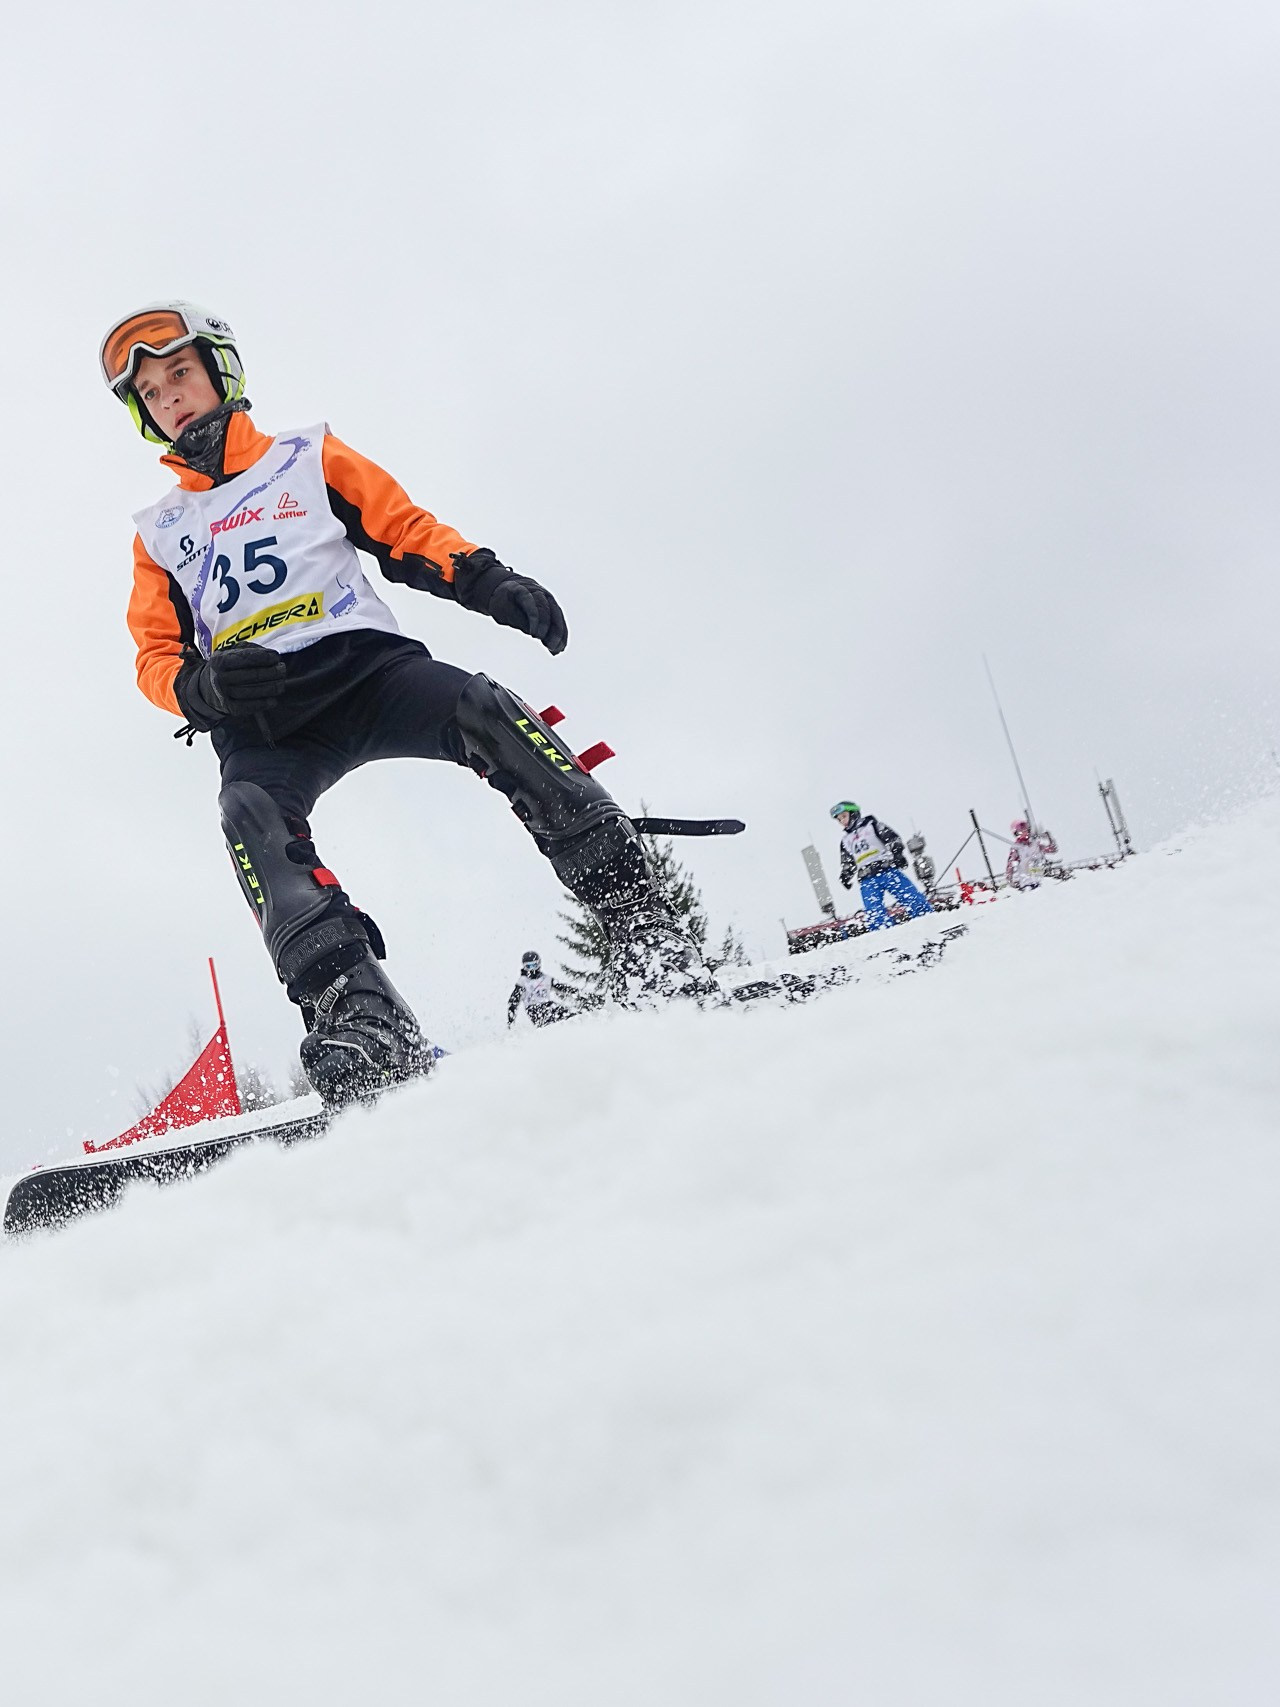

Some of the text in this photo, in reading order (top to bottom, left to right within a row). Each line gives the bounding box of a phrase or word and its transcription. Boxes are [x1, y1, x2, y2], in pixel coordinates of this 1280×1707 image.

[176, 543, 209, 572] SCOTT
[212, 535, 288, 614] 35
[515, 718, 573, 772] LEKI
[234, 842, 266, 904] LEKI
